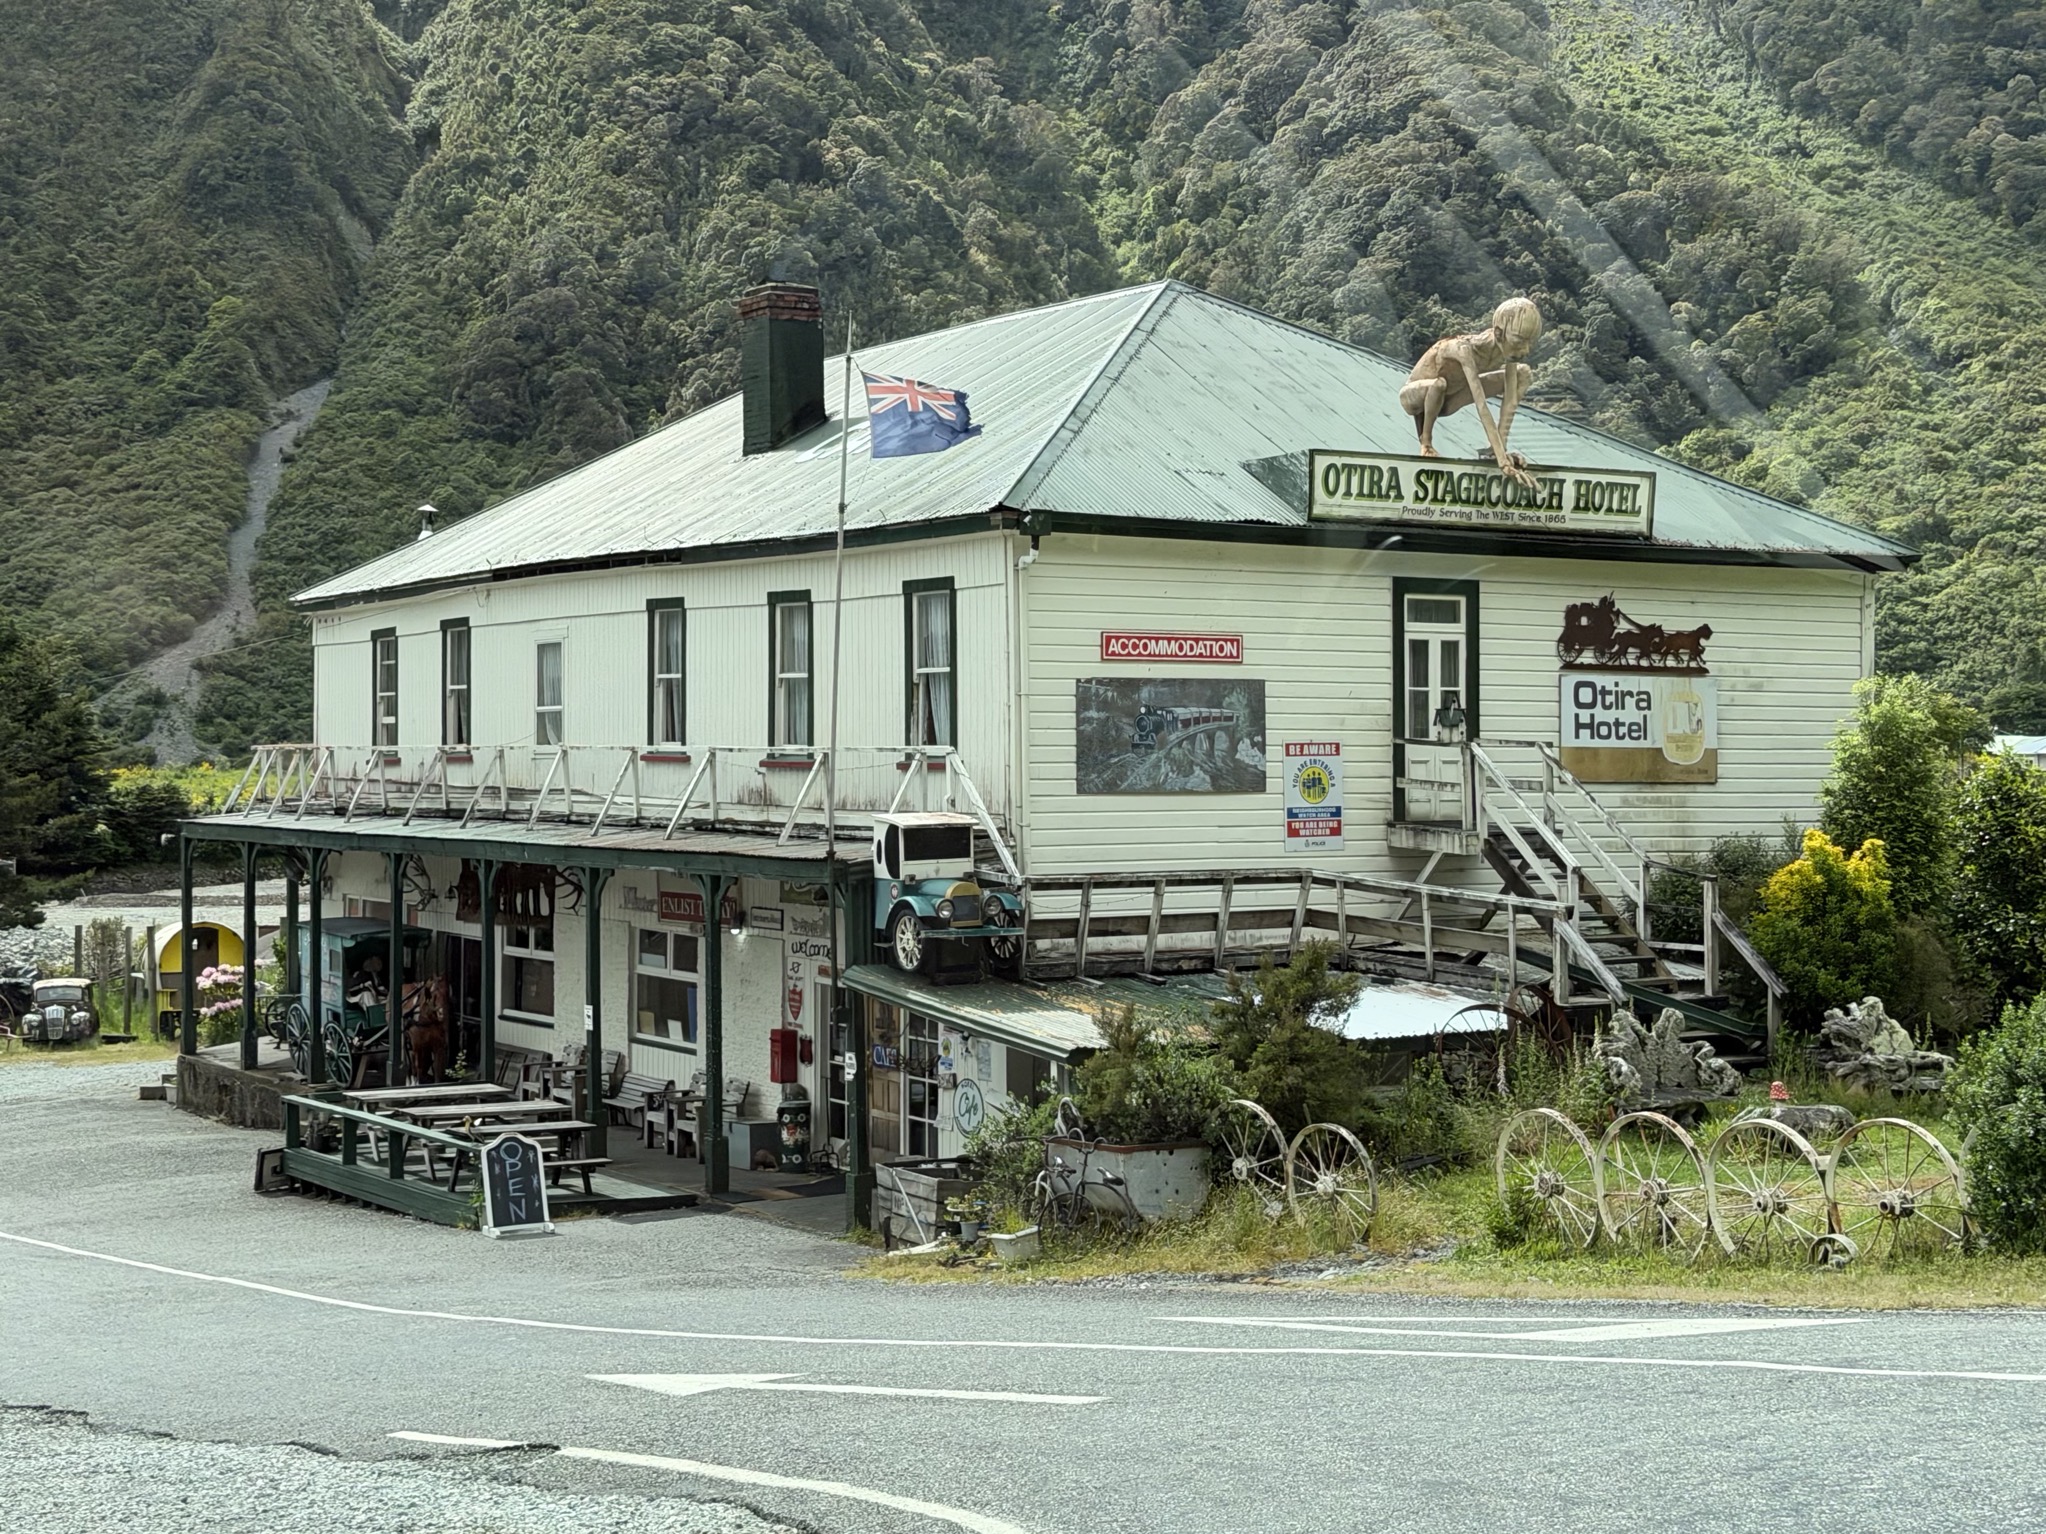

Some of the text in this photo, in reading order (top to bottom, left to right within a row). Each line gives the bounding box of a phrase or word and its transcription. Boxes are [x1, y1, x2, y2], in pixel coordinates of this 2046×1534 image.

[1321, 463, 1642, 517] OTIRA STAGECOACH HOTEL
[1402, 506, 1436, 518] Proudly
[1439, 508, 1472, 521] Serving
[1476, 510, 1490, 519] The
[1493, 511, 1515, 521] WEST
[1518, 512, 1541, 522] Since
[1108, 638, 1237, 657] ACCOMMODATION
[1573, 680, 1652, 711] Otira
[1574, 713, 1648, 741] Hotel
[1289, 744, 1337, 755] BE AWARE
[1292, 773, 1300, 788] YOU
[1297, 760, 1309, 773] ARE
[1309, 758, 1336, 781] ENTERING
[662, 897, 695, 915] ENLIST
[500, 1141, 527, 1223] OPEN
